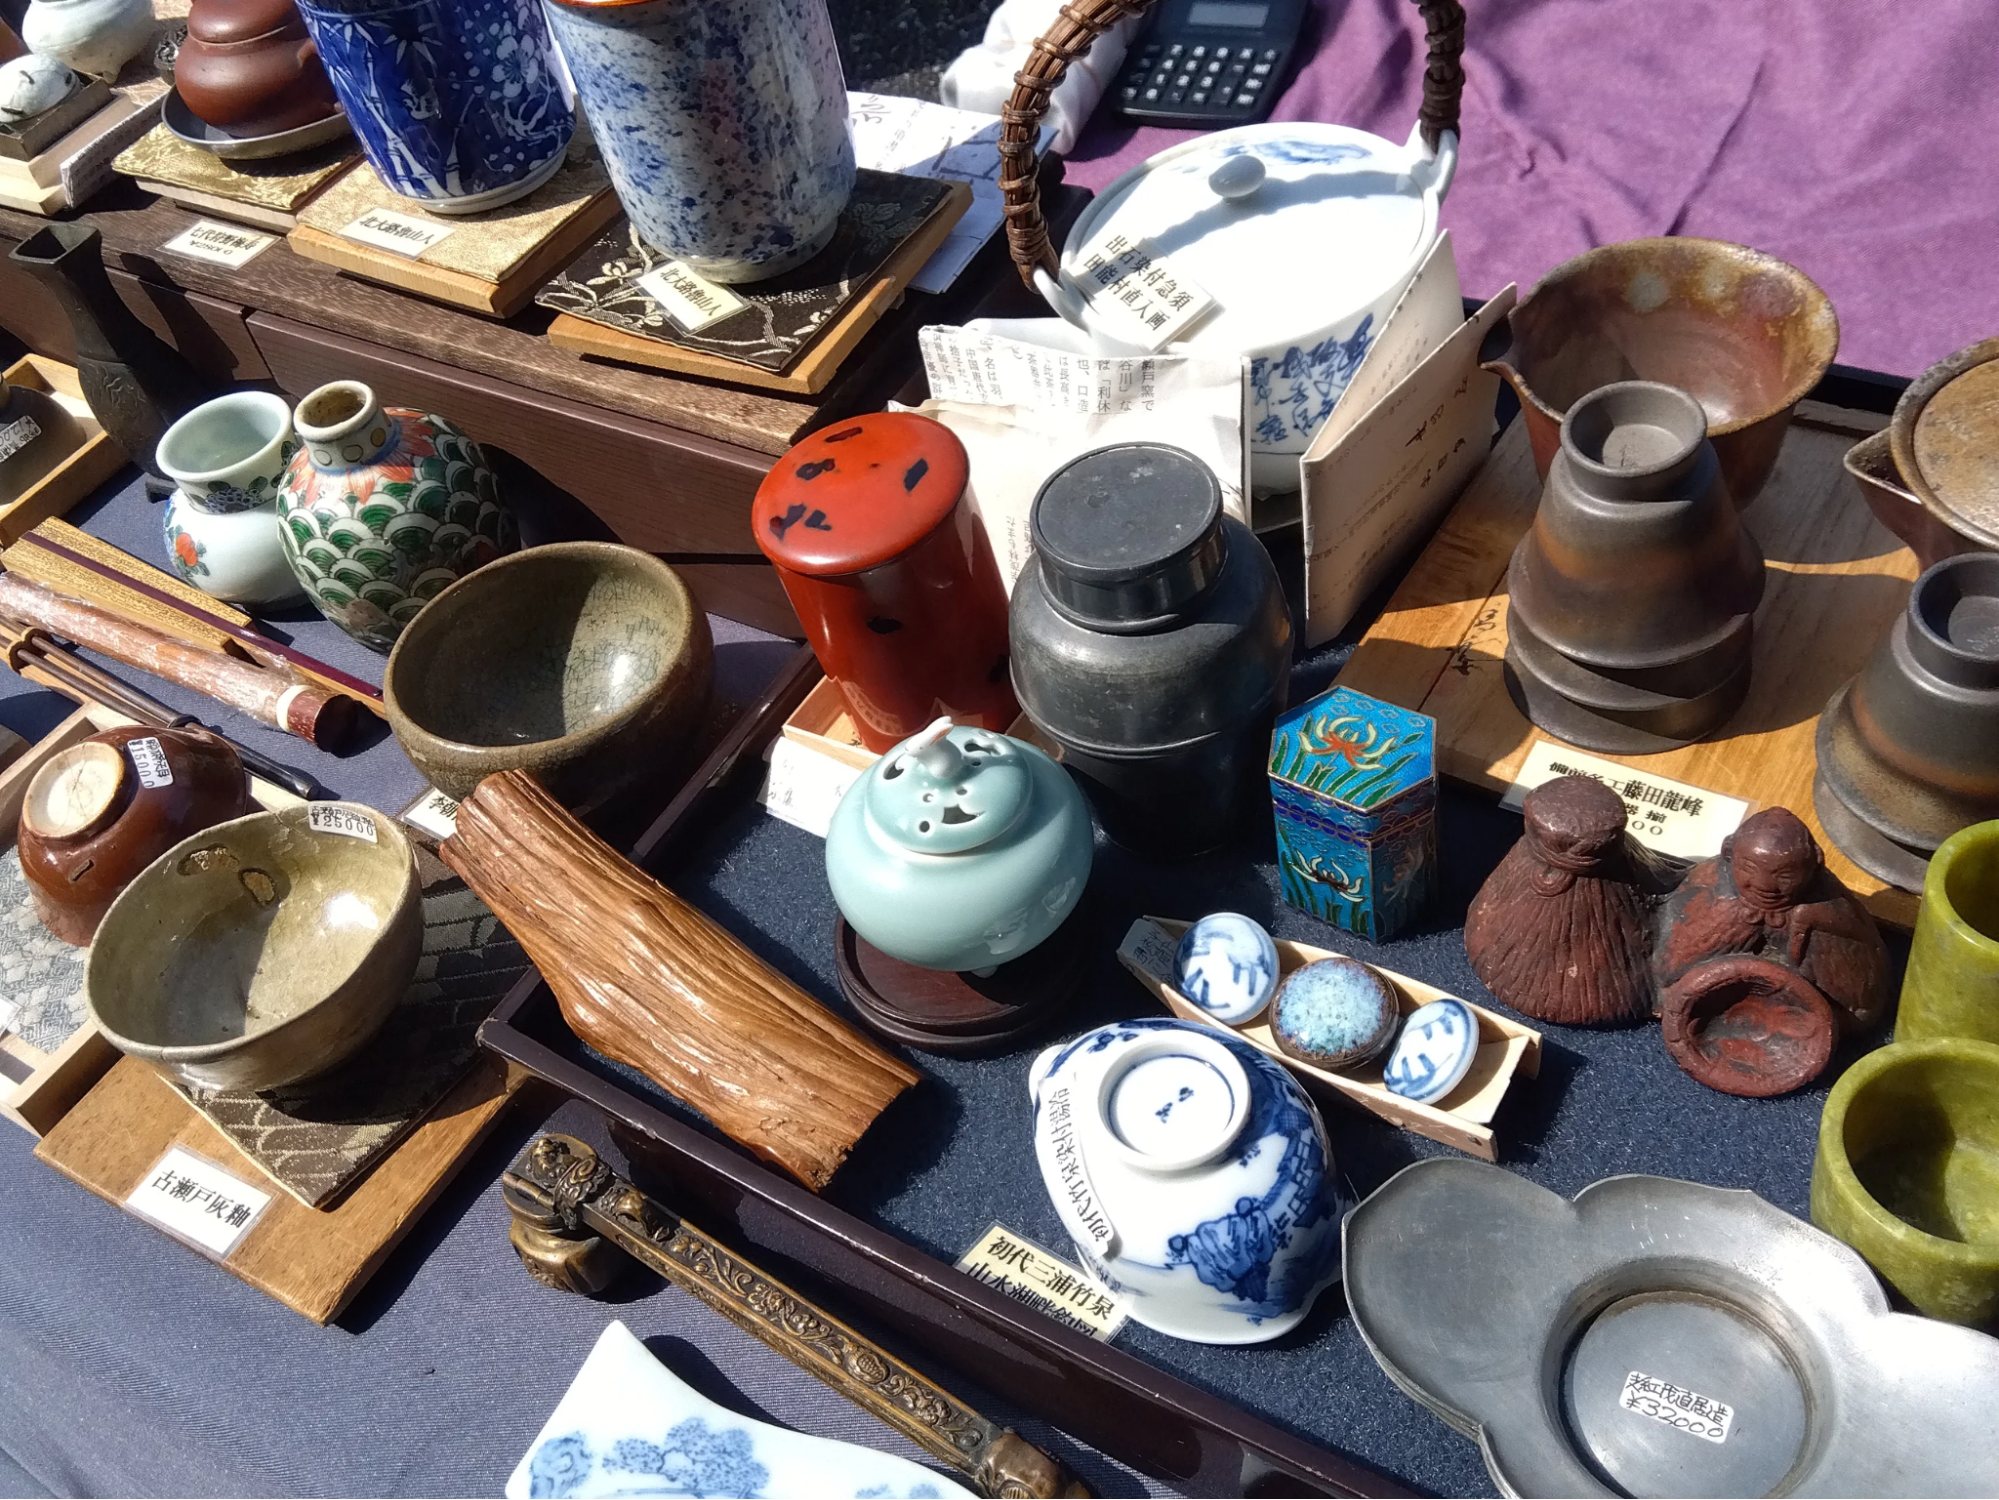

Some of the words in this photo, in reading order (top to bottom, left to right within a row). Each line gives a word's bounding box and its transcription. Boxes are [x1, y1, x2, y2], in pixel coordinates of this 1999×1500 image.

[660, 268, 722, 316] 北大路魯山人
[1083, 253, 1170, 331] 田能村直入画
[1105, 235, 1194, 312] 出石染付急須
[151, 1170, 251, 1229] 古瀬戸灰釉
[987, 1236, 1115, 1321] 初代三浦竹泉
[1626, 1390, 1724, 1437] ¥32000
